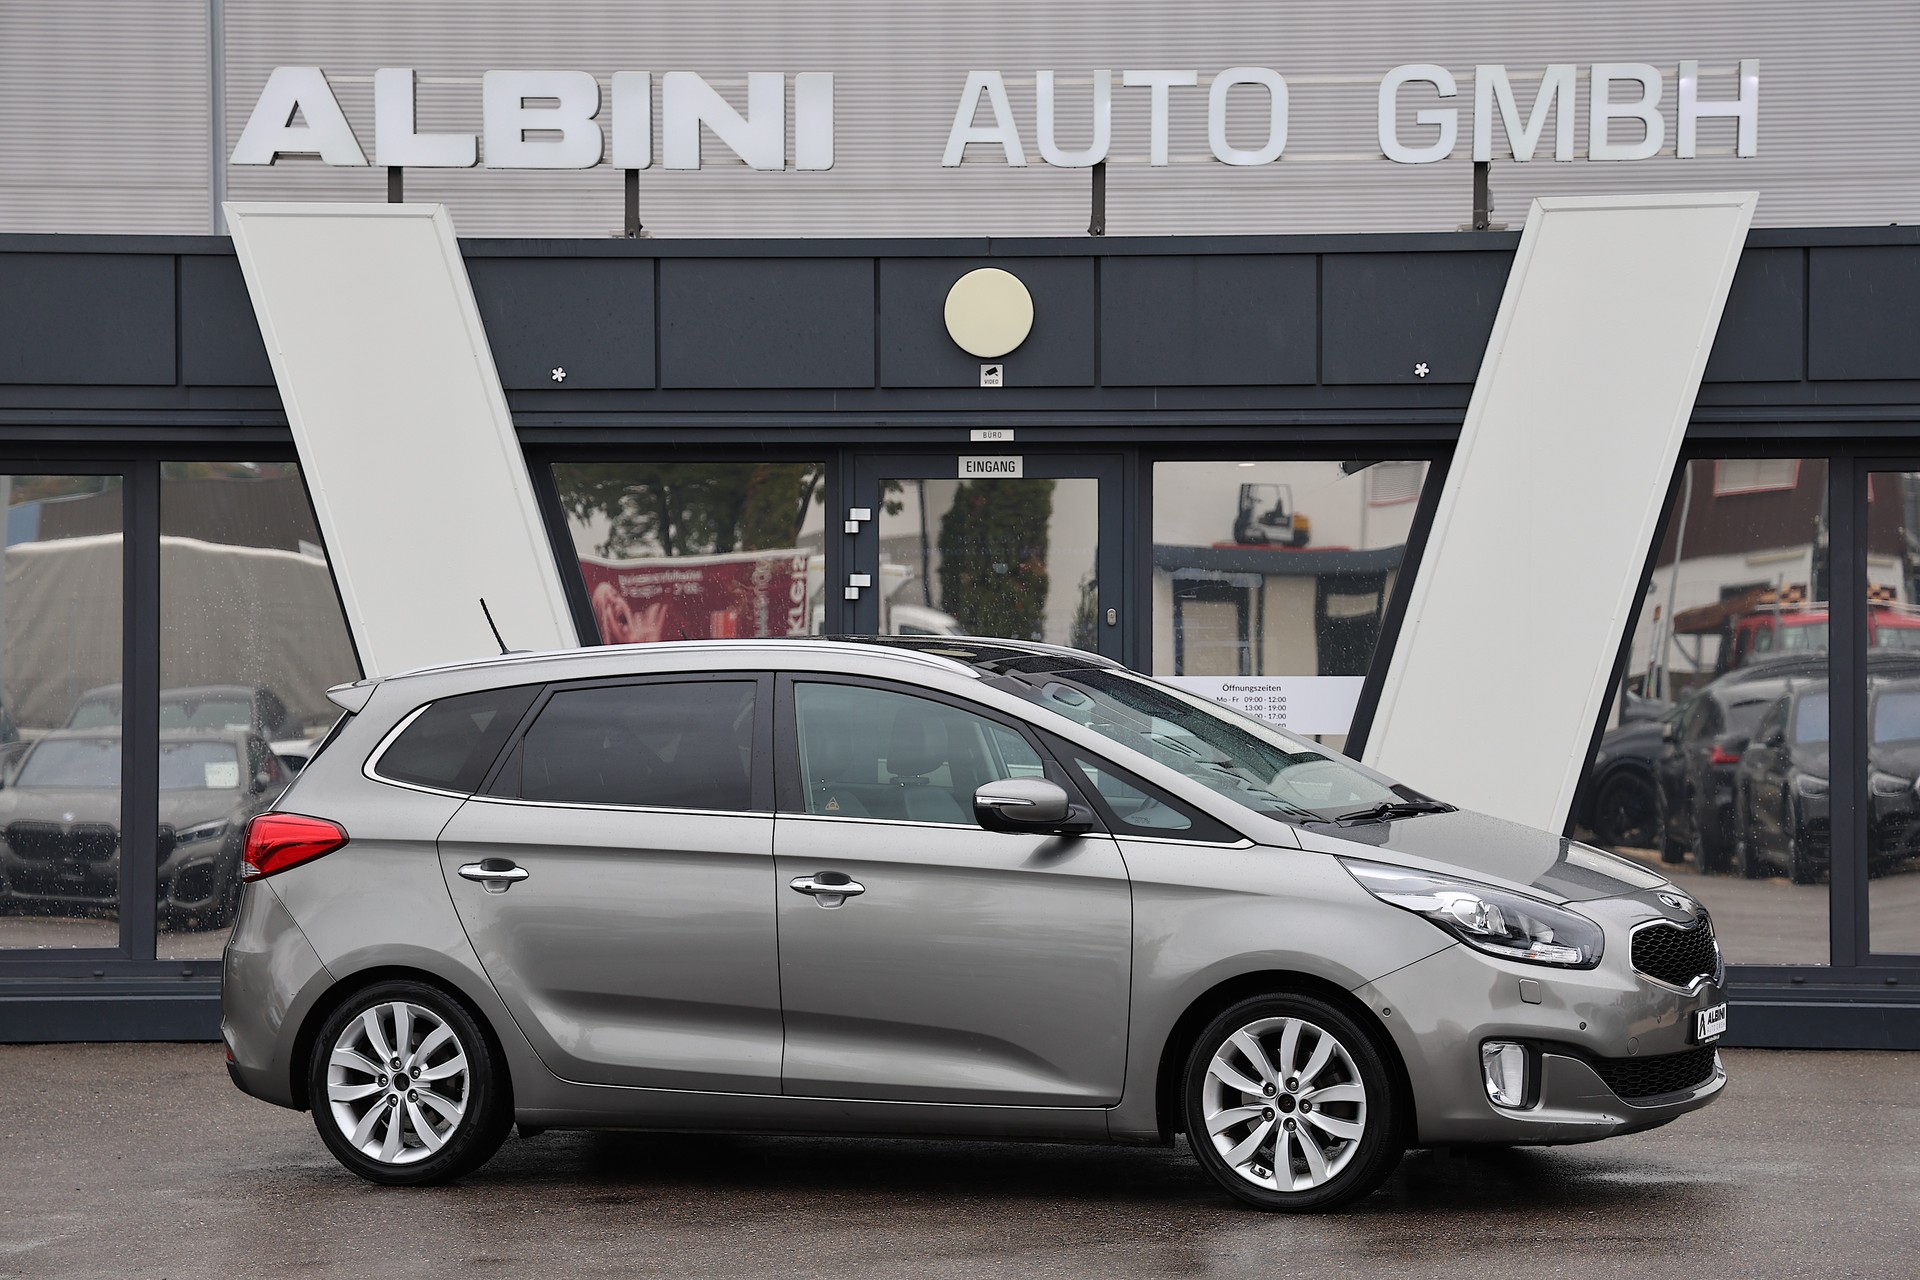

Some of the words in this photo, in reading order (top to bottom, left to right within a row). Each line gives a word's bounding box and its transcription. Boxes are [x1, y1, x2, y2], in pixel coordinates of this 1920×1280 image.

[229, 66, 835, 171] ALBINI
[941, 66, 1289, 169] AUTO
[1377, 58, 1760, 164] GMBH
[982, 431, 1002, 439] BÜRO
[966, 460, 1016, 473] EINGANG
[1222, 684, 1281, 692] Öffnungszeiten
